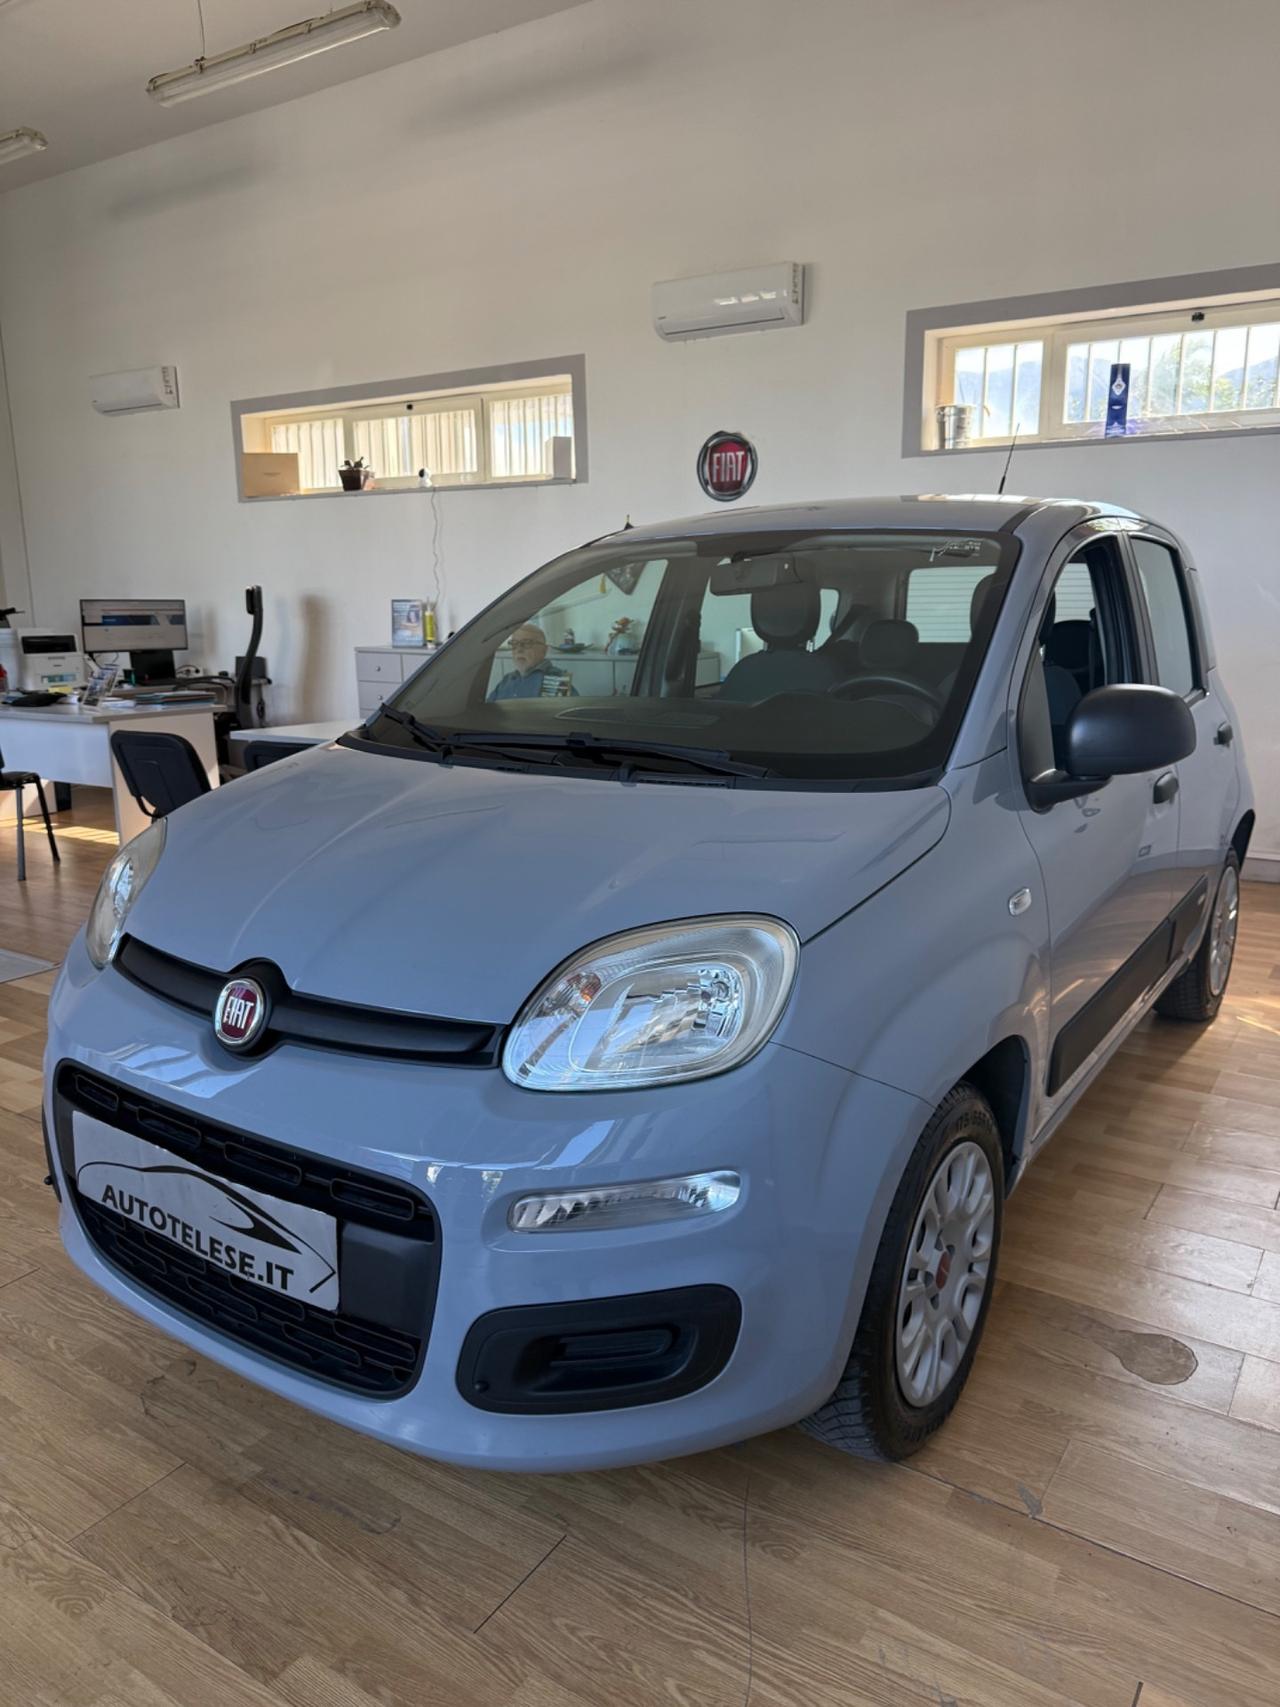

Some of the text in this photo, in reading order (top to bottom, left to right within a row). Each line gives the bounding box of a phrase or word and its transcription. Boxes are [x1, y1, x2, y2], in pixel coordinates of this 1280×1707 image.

[712, 450, 745, 482] FIAT
[222, 996, 255, 1030] FIAT
[101, 1184, 294, 1291] AUTOTELESE.IT
